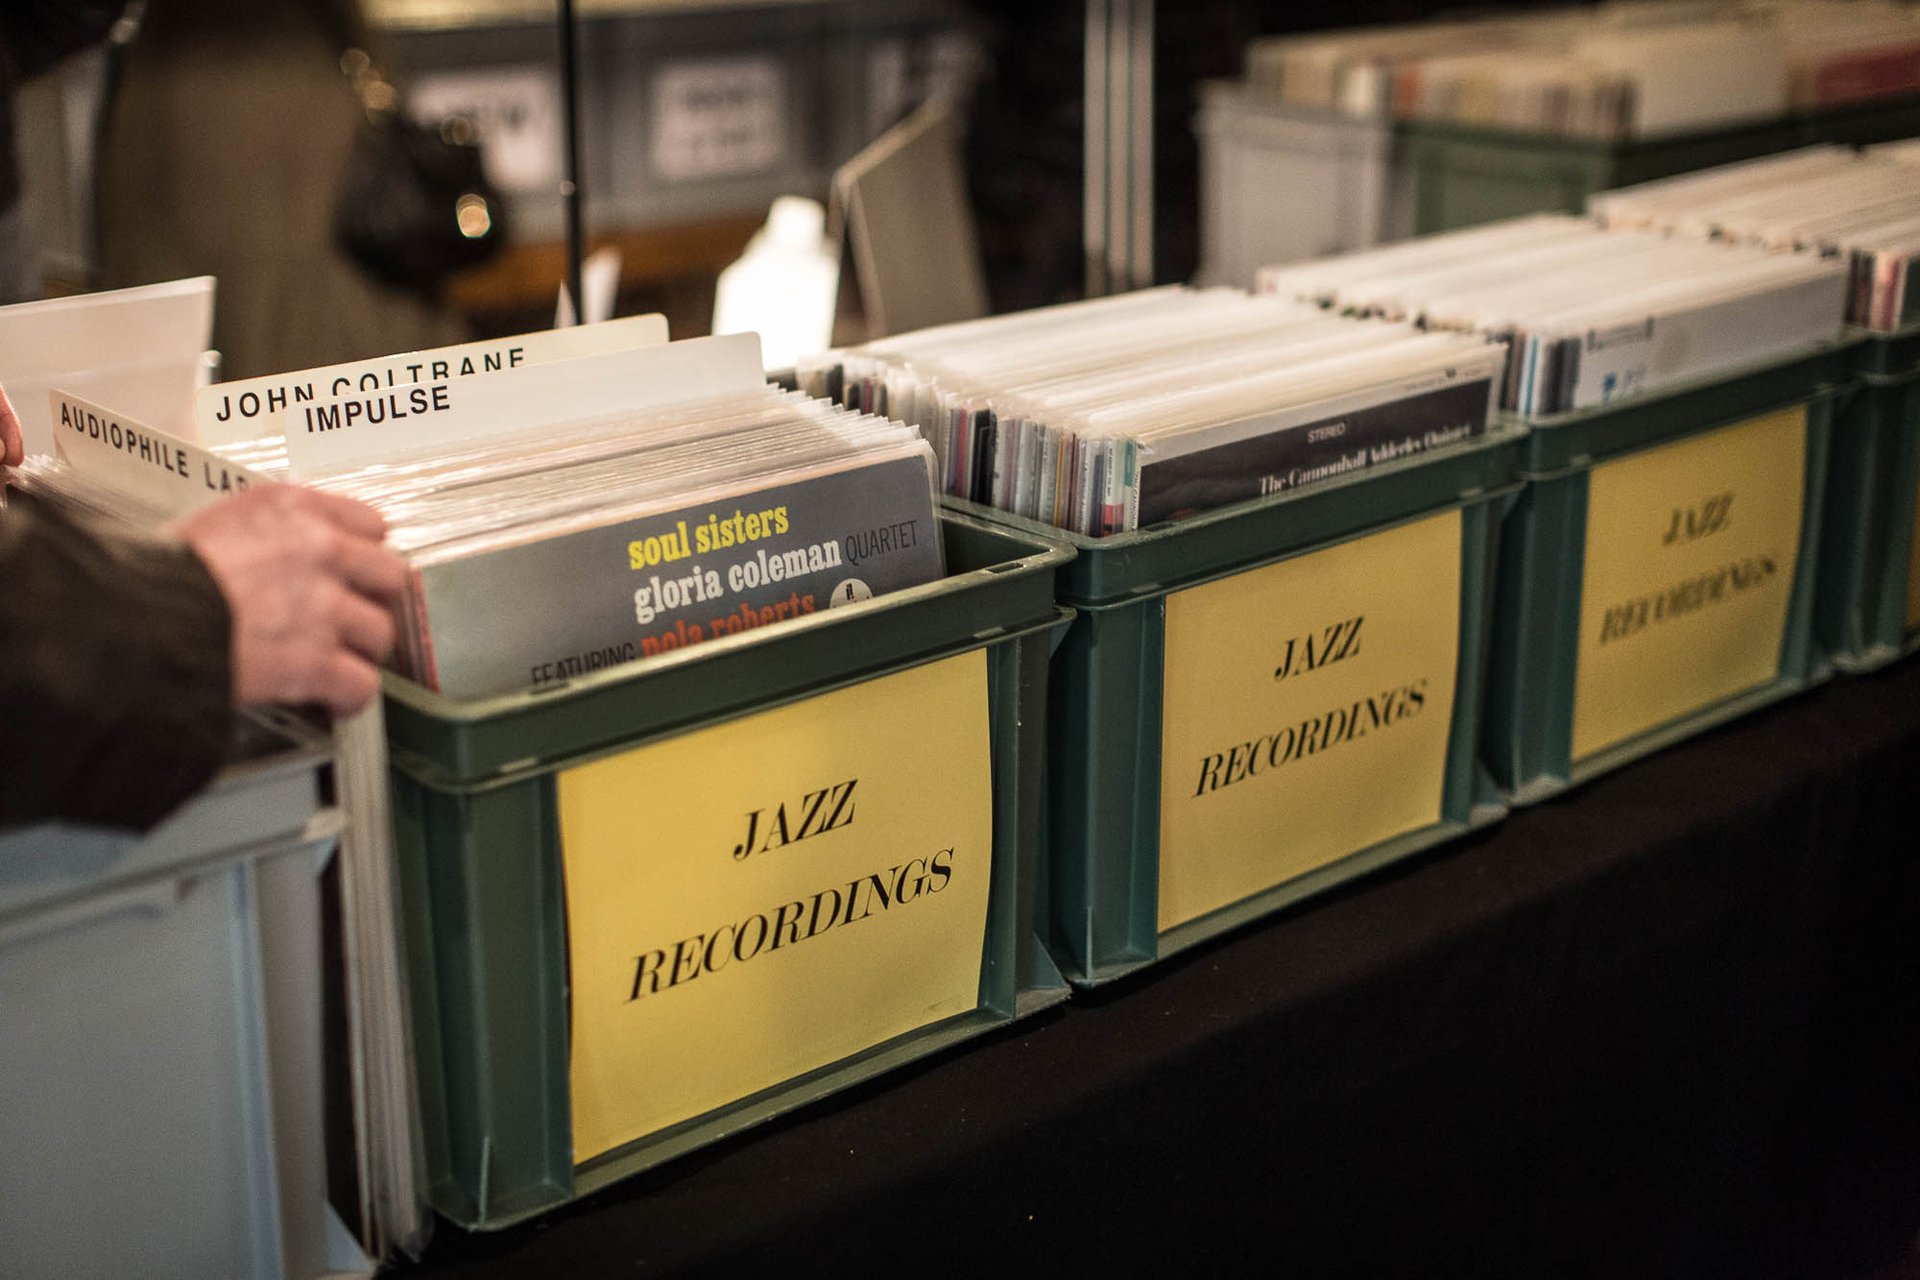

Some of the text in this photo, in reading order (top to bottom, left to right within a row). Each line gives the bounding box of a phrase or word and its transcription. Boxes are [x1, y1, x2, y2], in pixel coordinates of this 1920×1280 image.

[216, 383, 314, 421] JOHN
[305, 385, 450, 432] IMPULSE
[1307, 421, 1346, 444] STEREO
[60, 402, 190, 478] AUDIOPHILE
[1259, 474, 1287, 495] The
[628, 505, 790, 570] soul sisters
[634, 520, 917, 625] gloria coleman QUARTET
[532, 642, 636, 685] FEATURING
[710, 592, 816, 640] roberts
[1274, 616, 1365, 683] JAZZ
[1191, 677, 1428, 799] RECORDINGS
[733, 779, 858, 862] JAZZ
[623, 847, 955, 1005] RECORDINGS
